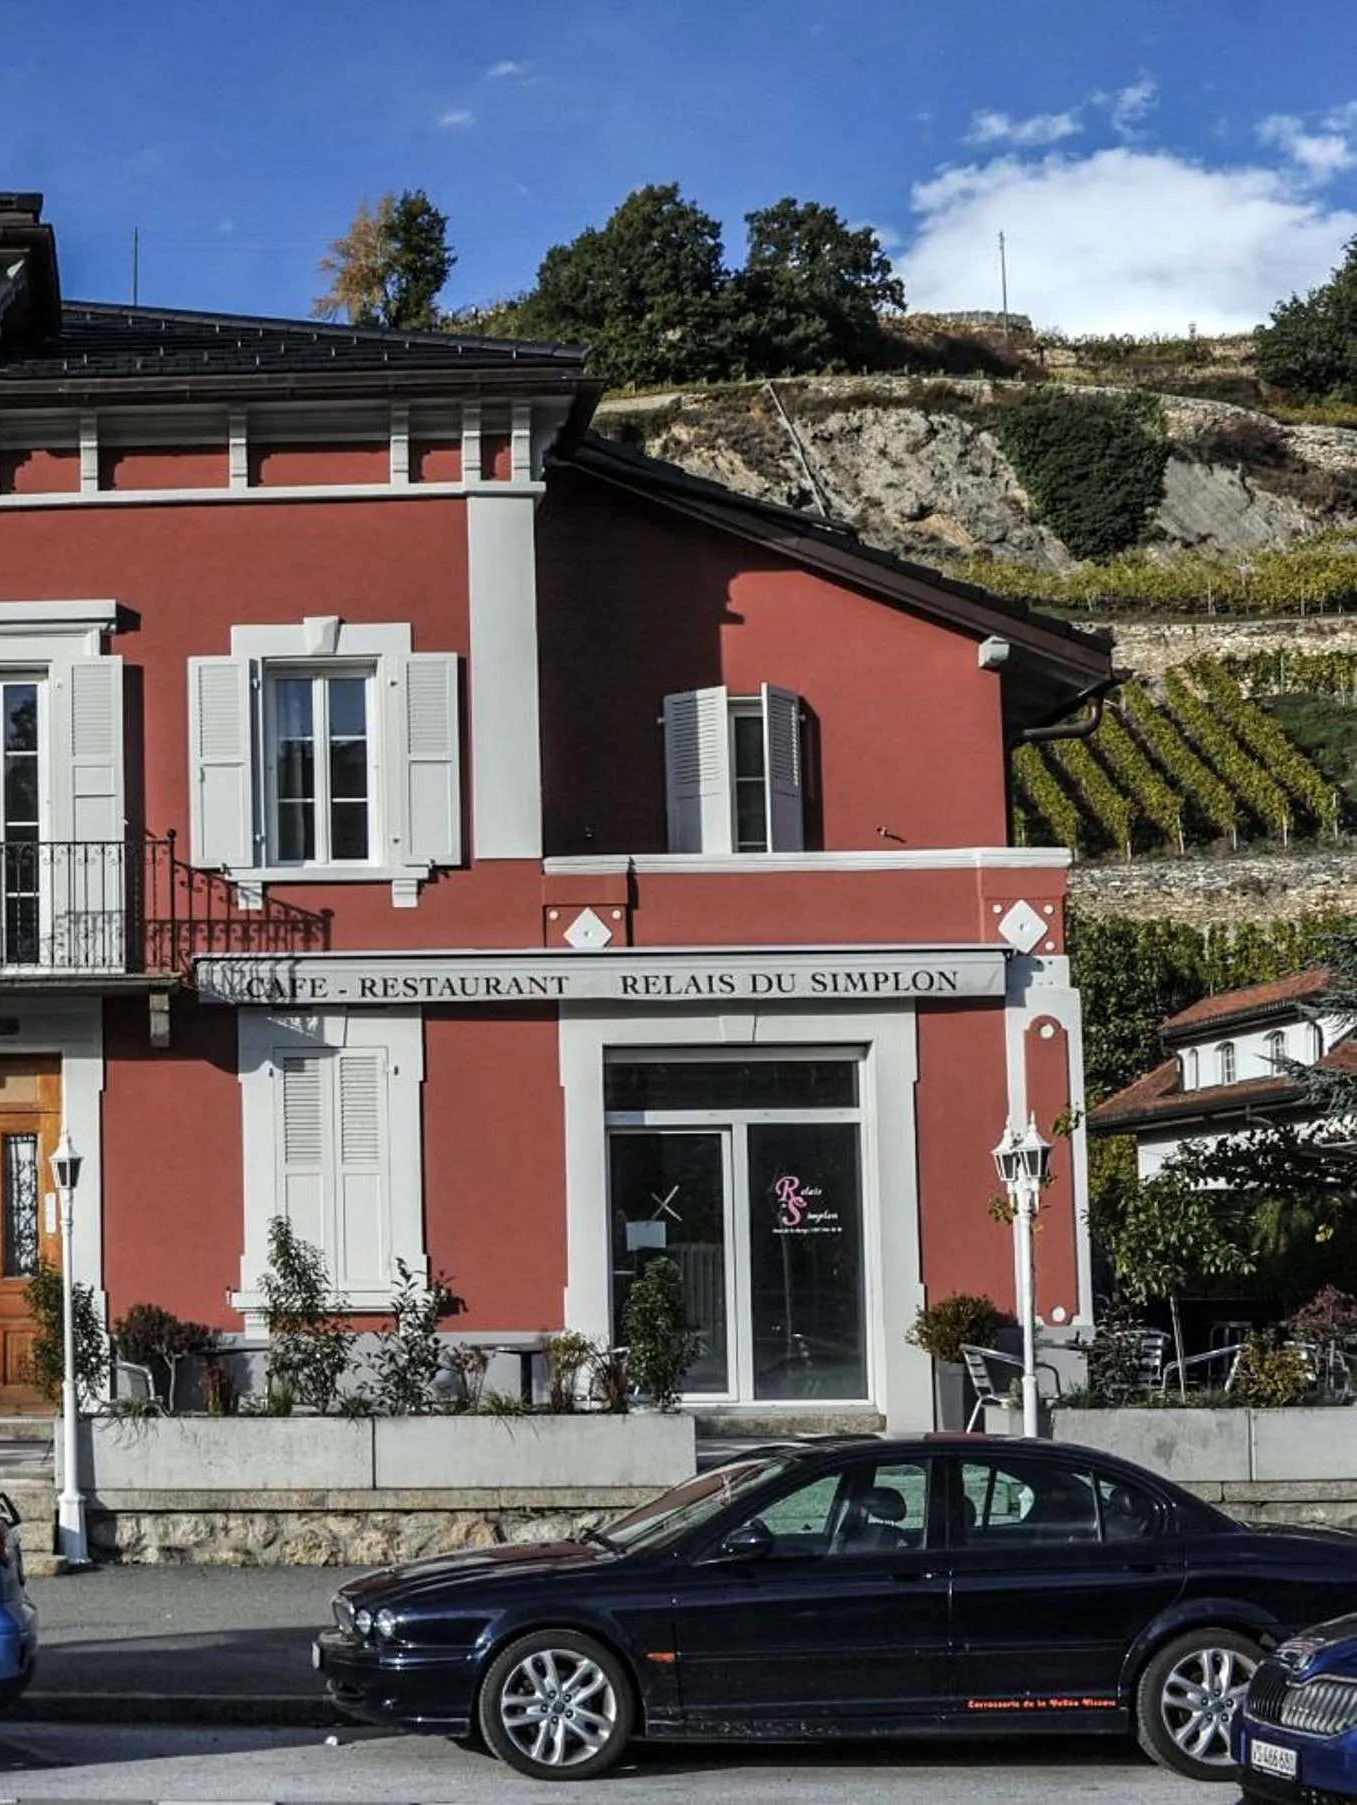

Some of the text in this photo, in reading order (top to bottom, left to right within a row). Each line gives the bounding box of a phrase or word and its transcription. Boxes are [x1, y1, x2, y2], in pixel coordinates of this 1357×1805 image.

[245, 976, 328, 998] CAFE
[358, 975, 569, 998] RESTAURANT
[620, 974, 736, 995] RELAIS
[750, 973, 796, 993] DU
[811, 970, 958, 993] SIMPLON
